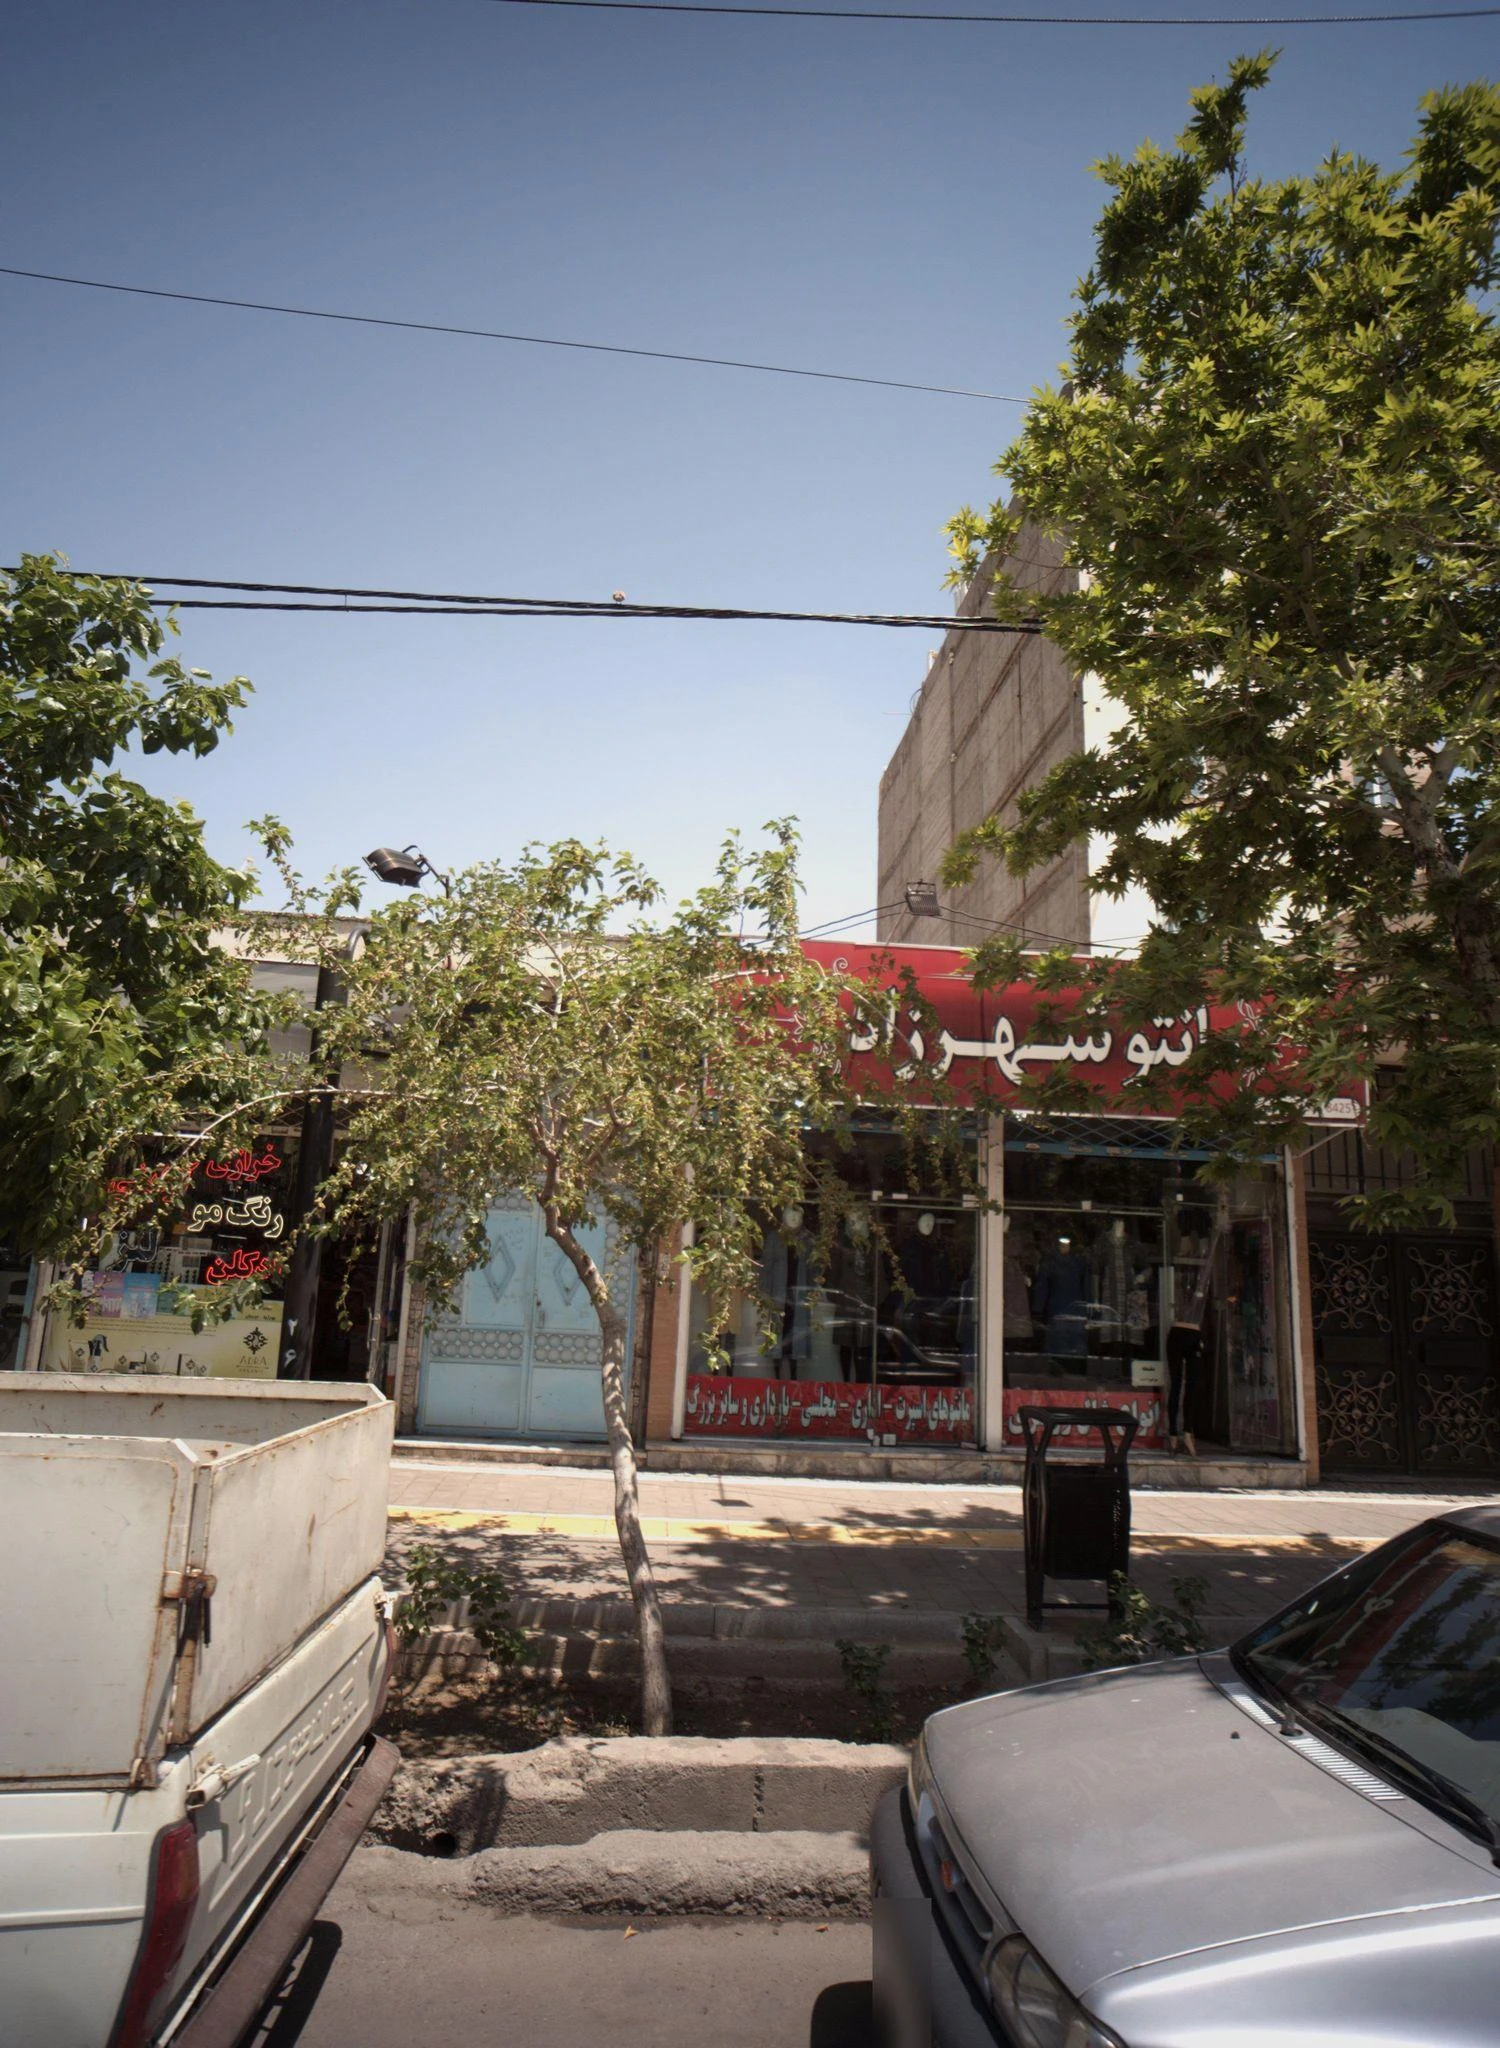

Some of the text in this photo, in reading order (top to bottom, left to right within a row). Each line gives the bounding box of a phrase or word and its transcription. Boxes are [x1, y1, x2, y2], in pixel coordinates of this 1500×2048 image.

[1122, 1003, 1214, 1087] انتو
[206, 1143, 282, 1182] خرازی
[187, 1196, 284, 1238] رنگ مو
[687, 1382, 715, 1425] بزرگ
[716, 1383, 739, 1426] سایز
[801, 1385, 836, 1427] مجلسی
[895, 1389, 927, 1432] اسپرت
[928, 1389, 970, 1432] مانتوهای
